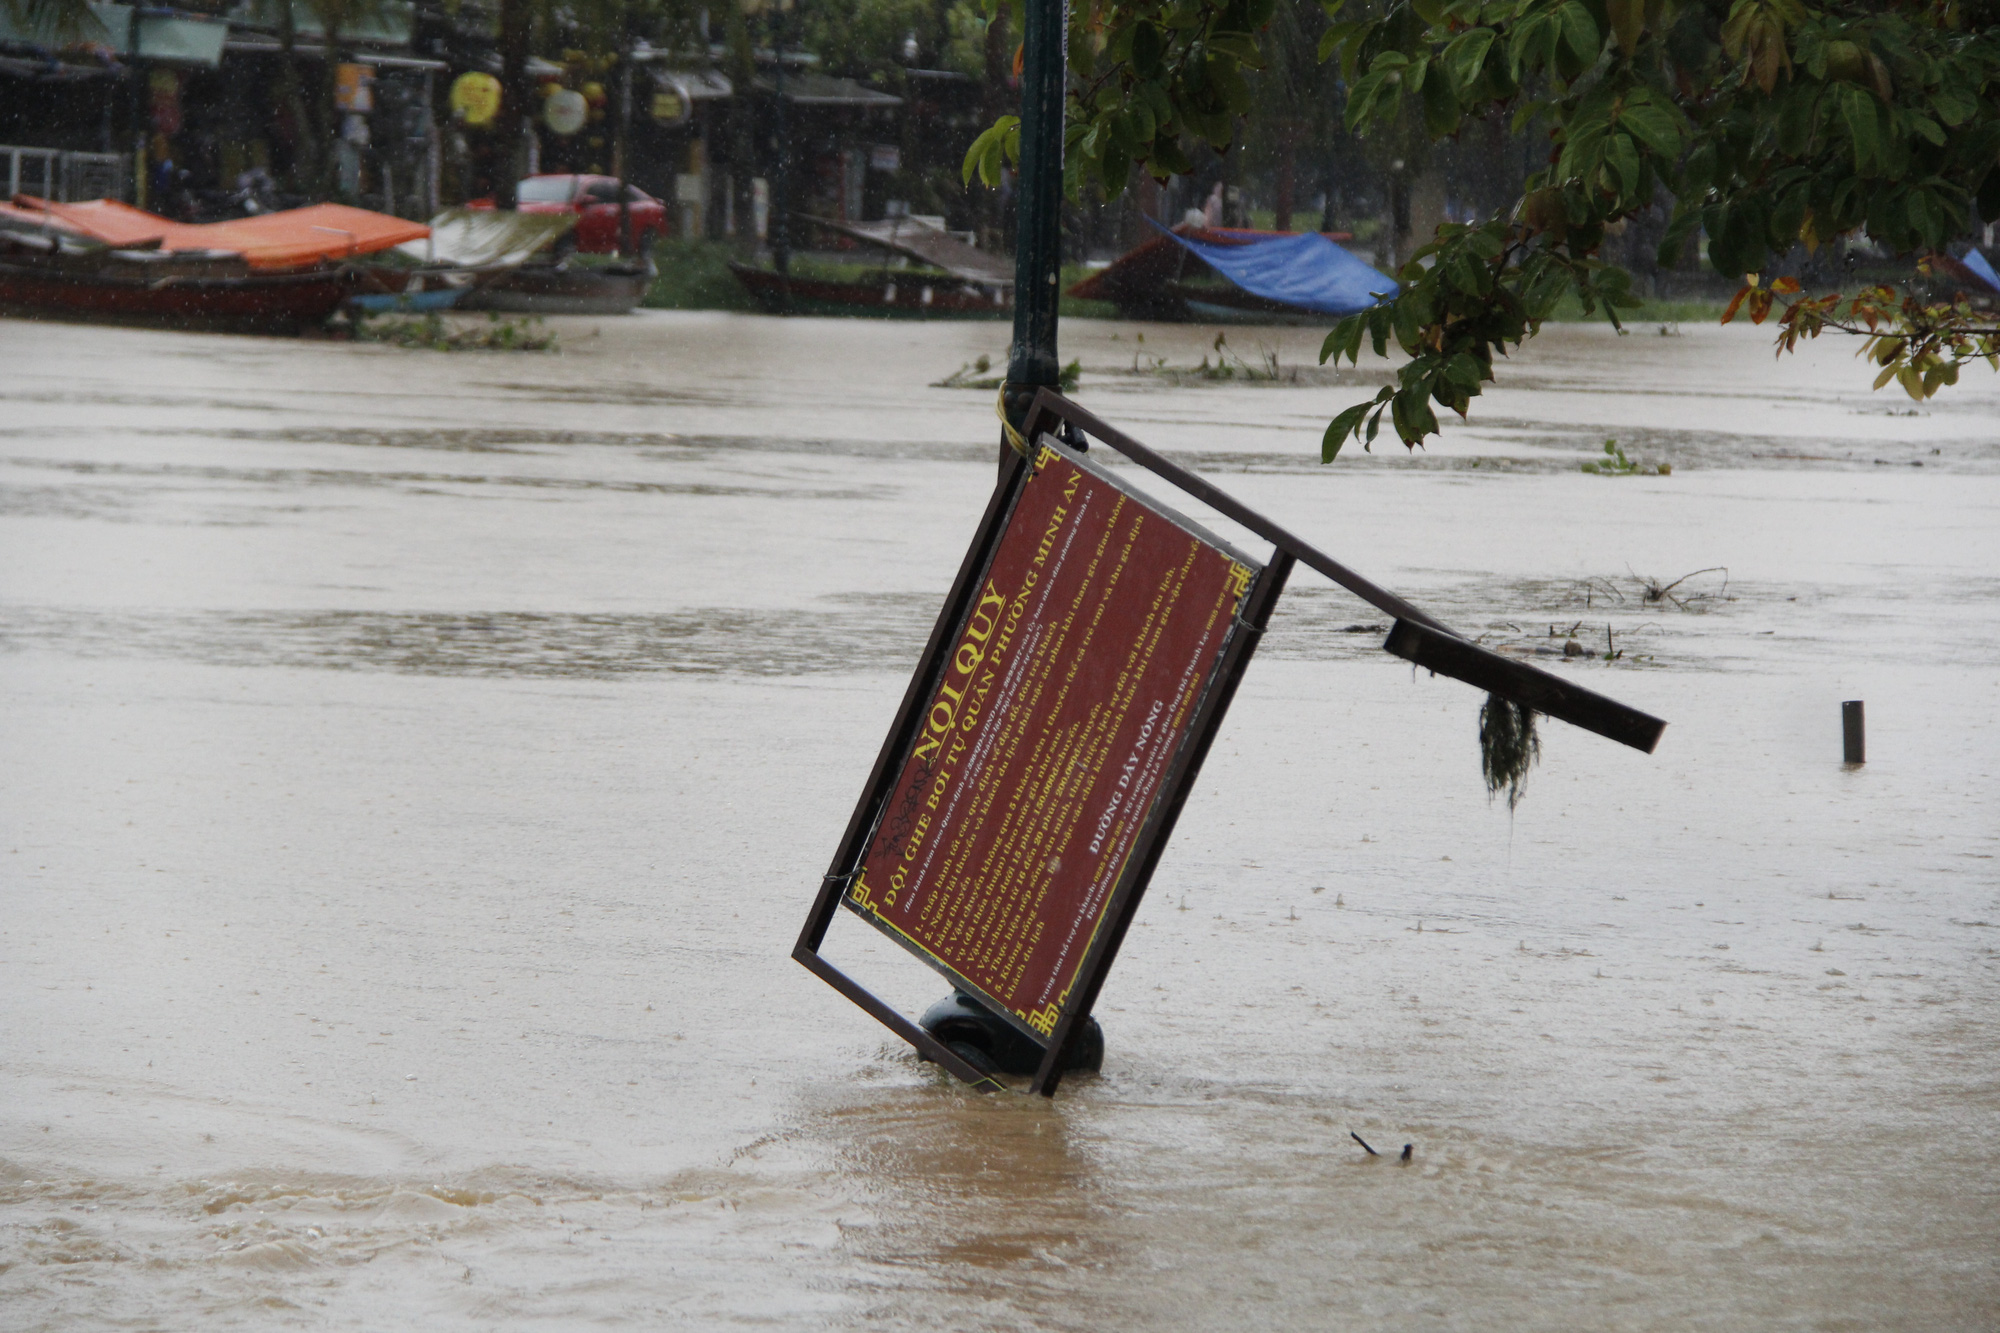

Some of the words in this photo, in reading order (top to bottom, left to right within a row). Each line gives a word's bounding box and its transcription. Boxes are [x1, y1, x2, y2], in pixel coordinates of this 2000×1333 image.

[1107, 492, 1128, 529] thông
[1129, 515, 1145, 542] dịch
[1096, 530, 1111, 557] giao
[1120, 543, 1133, 564] giá
[1087, 558, 1099, 578] gia
[1109, 563, 1124, 585] thu
[1159, 567, 1176, 593] lịch.
[1072, 578, 1090, 610] tham
[1103, 587, 1113, 601] và
[1152, 594, 1164, 611] du
[1060, 610, 1076, 632] khi
[1092, 603, 1106, 627] em)
[1133, 612, 1156, 650] khách
[1048, 633, 1066, 665] phao
[1076, 647, 1086, 662] cả
[1126, 650, 1139, 669] với
[912, 678, 966, 771] NỘI
[951, 576, 1008, 676] QUY
[1041, 664, 1052, 680] áo
[1116, 670, 1129, 692] đối
[883, 863, 909, 908] ĐỘI
[904, 812, 932, 862] GHE
[925, 768, 952, 812] BƠI
[945, 731, 967, 766] TỰ
[961, 667, 995, 732] QUẢN
[989, 569, 1039, 667] PHƯỜNG
[1032, 504, 1068, 569] MINH
[1063, 468, 1083, 504] AN
[1029, 680, 1044, 707] mặc
[1109, 691, 1120, 708] sự
[1017, 706, 1033, 736] phải
[1096, 709, 1113, 733] lịch
[1004, 736, 1021, 759] lịch
[1030, 737, 1046, 763] trên
[914, 924, 924, 933] 1.
[920, 890, 939, 921] Chấp
[934, 858, 953, 889] hành
[949, 839, 961, 857] tốt
[958, 817, 971, 838] các
[968, 792, 981, 816] quy
[978, 764, 995, 792] định
[991, 745, 1001, 762] về
[998, 723, 1013, 747] đậu
[1018, 679, 1032, 702] đón
[1028, 658, 1041, 678] trả
[1036, 620, 1059, 658] khách
[998, 760, 1009, 777] du
[1088, 790, 1124, 855] ĐƯỜNG
[1117, 751, 1140, 790] DÂY
[1134, 699, 1164, 752] NÓNG
[994, 983, 1004, 993] 5.
[999, 940, 1023, 981] Không
[1019, 909, 1038, 940] uống
[1033, 877, 1053, 909] rượu,
[1056, 824, 1074, 854] hoặc
[1071, 802, 1084, 824] các
[1081, 774, 1097, 802] chất
[1092, 746, 1110, 773] kích
[1105, 713, 1125, 745] thích
[1119, 681, 1138, 712] khác
[1133, 658, 1148, 681] khi
[1144, 626, 1163, 658] tham
[1160, 606, 1172, 626] gia
[1169, 581, 1183, 604] vận
[1012, 764, 1034, 801] khách
[1068, 771, 1086, 799] thân
[979, 778, 1002, 816] khách
[1008, 801, 1017, 811] 5
[974, 816, 985, 831] và
[999, 812, 1013, 835] quá
[1052, 801, 1073, 835] minh,
[955, 947, 967, 962] vụ
[985, 856, 1007, 896] thuận)
[1003, 828, 1019, 855] theo
[1016, 800, 1031, 827] mức
[1028, 780, 1041, 801] giá
[1037, 753, 1052, 779] như
[1049, 728, 1064, 754] sau:
[980, 835, 1003, 874] không
[1042, 836, 1056, 858] văn
[976, 947, 993, 969] Vận
[1009, 885, 1020, 901] từ
[1015, 870, 1027, 886] 16
[1023, 847, 1038, 870] đến
[1033, 830, 1044, 847] 20
[1041, 798, 1059, 832] phút:
[1029, 859, 1046, 889] sống
[966, 940, 983, 962] Vận
[999, 865, 1016, 894] dưới
[1011, 849, 1022, 865] 15
[1019, 817, 1038, 851] phút:
[1018, 889, 1032, 913] nếp
[929, 892, 951, 929] Người
[924, 931, 934, 942] 2.
[949, 919, 966, 941] Vận
[1004, 914, 1022, 941] hiện
[943, 946, 954, 956] 3.
[989, 942, 1008, 972] Thực
[1004, 964, 1026, 1001] khách
[1023, 946, 1034, 962] du
[1029, 921, 1045, 944] lịch
[985, 975, 994, 985] 4.
